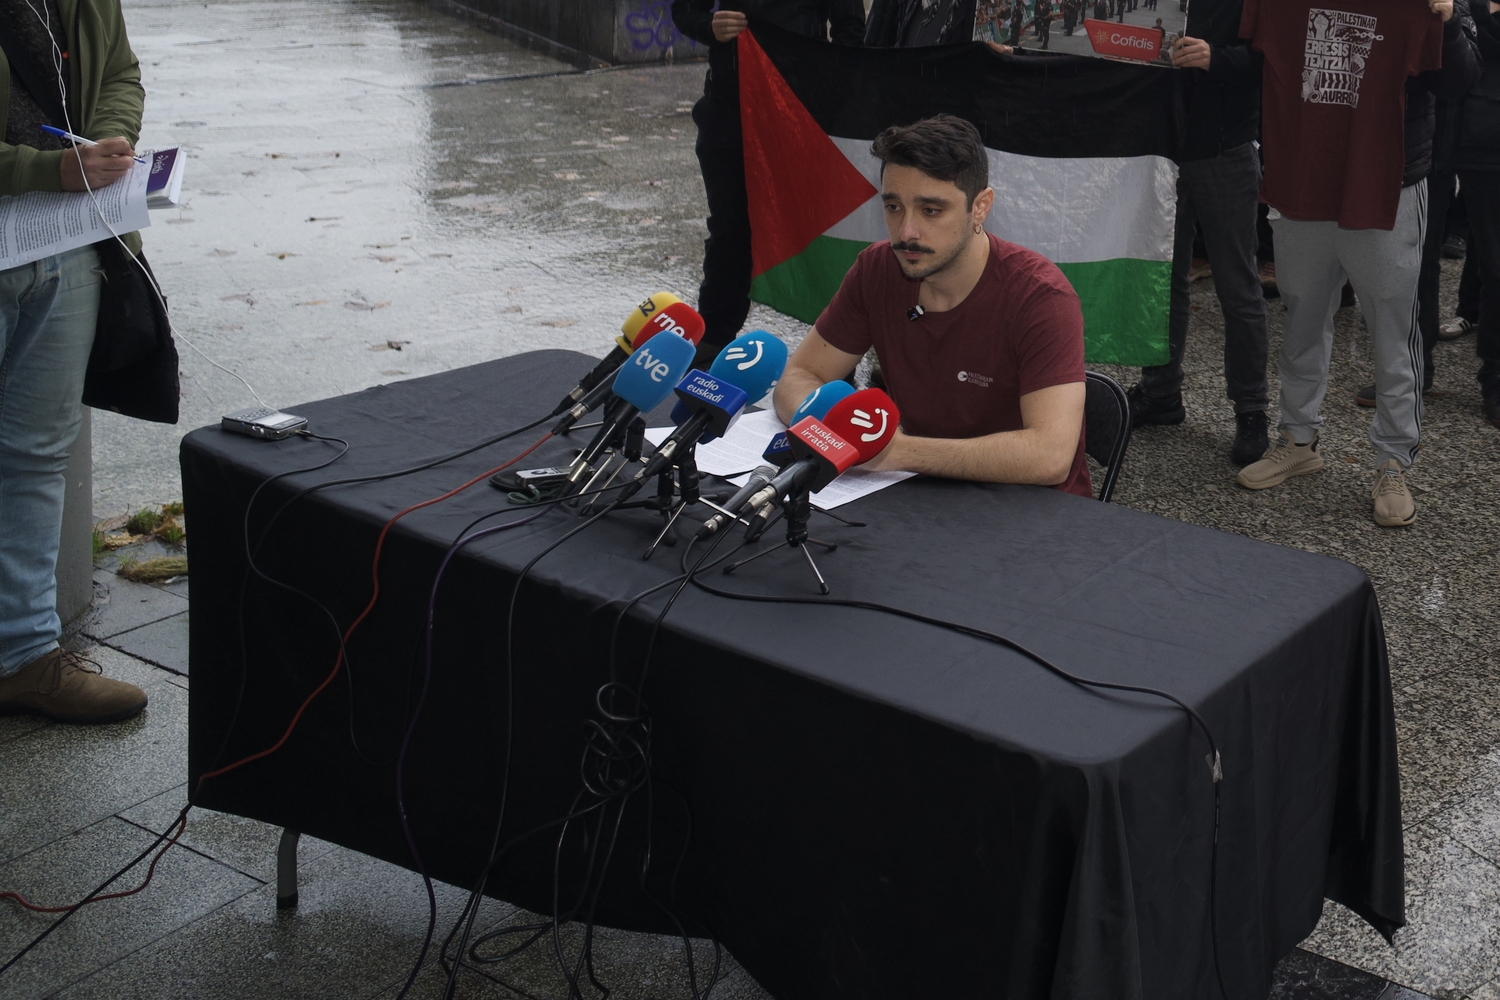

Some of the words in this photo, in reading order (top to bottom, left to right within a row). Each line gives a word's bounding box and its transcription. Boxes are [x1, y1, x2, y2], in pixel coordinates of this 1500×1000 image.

[1336, 12, 1376, 30] PALESTINAR
[1110, 33, 1154, 51] Cofidis
[1305, 40, 1350, 56] ERRESIS
[1304, 54, 1350, 71] TENTZIA
[653, 312, 685, 338] rne
[635, 348, 669, 383] tve
[693, 375, 719, 391] radio
[686, 384, 725, 403] euskadi
[801, 428, 829, 452] irratia
[809, 424, 846, 450] euskadi
